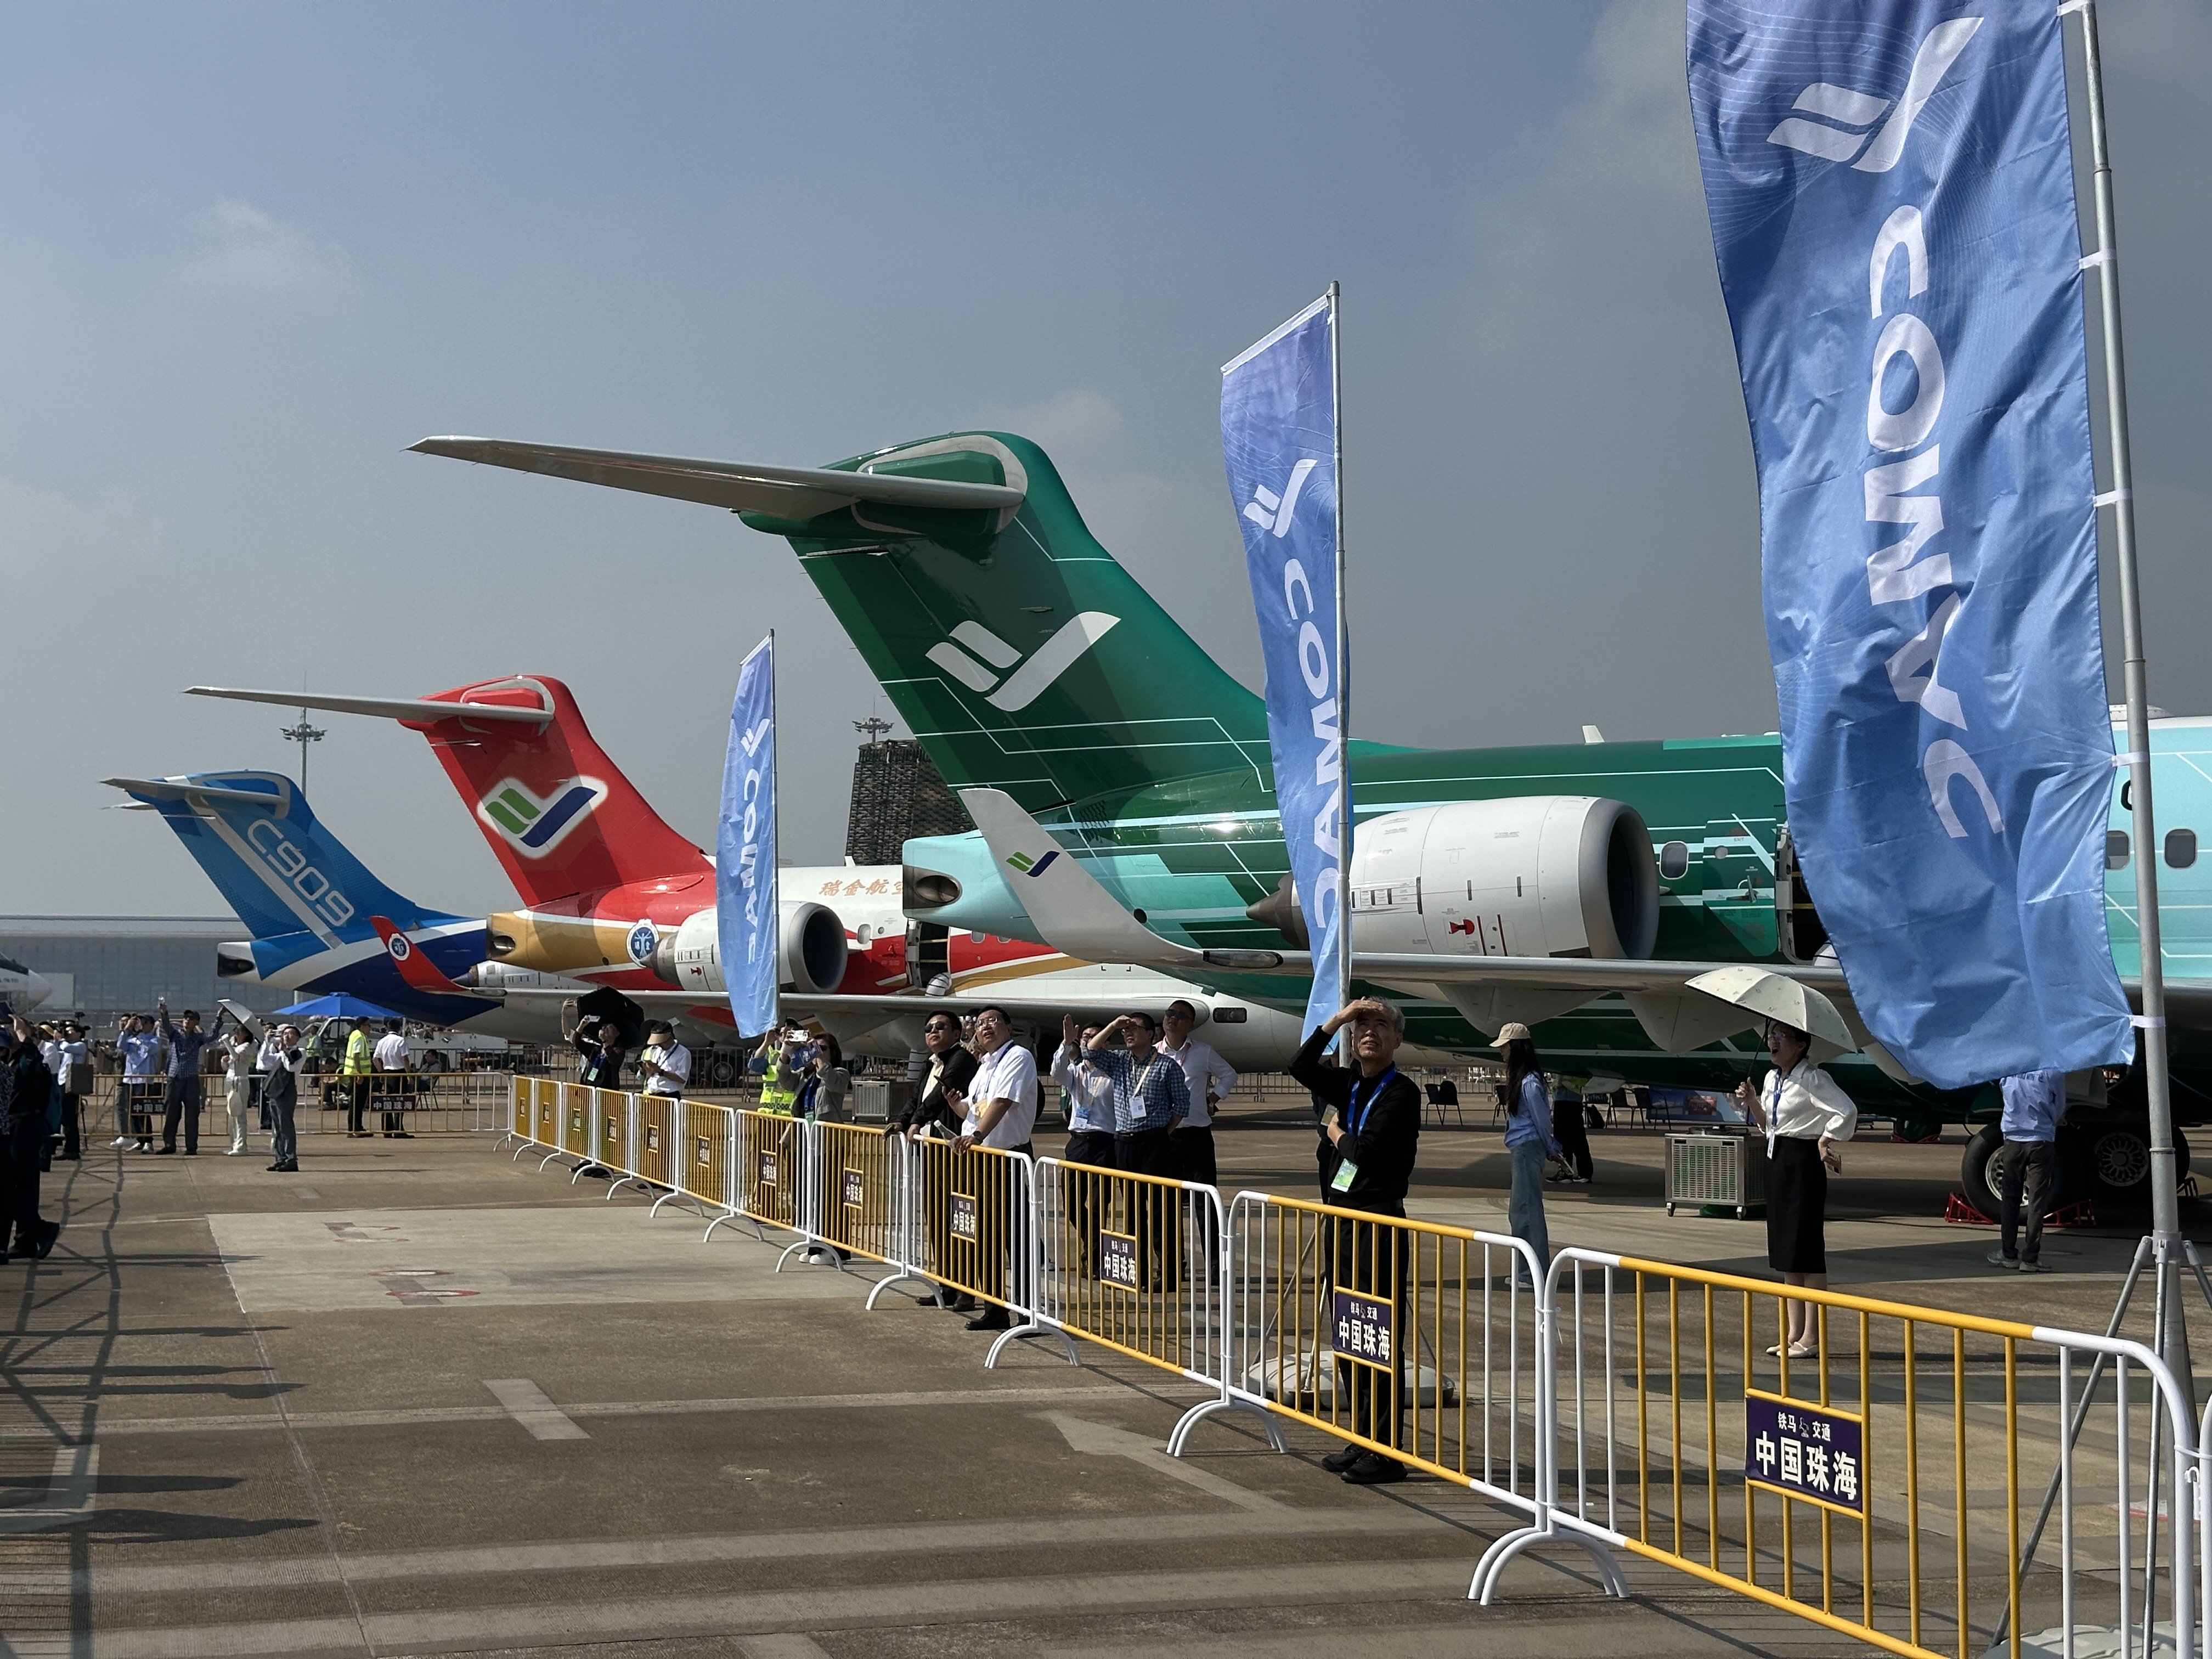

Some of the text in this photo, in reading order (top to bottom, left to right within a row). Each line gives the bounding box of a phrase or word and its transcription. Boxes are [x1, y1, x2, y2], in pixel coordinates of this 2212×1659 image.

[248, 819, 354, 926] C909
[1104, 1251, 1136, 1284] 中国珠海
[1339, 1316, 1390, 1360] 中国珠海
[1778, 1411, 1831, 1441] 铁马 交通
[1755, 1430, 1858, 1500] 中国珠海
